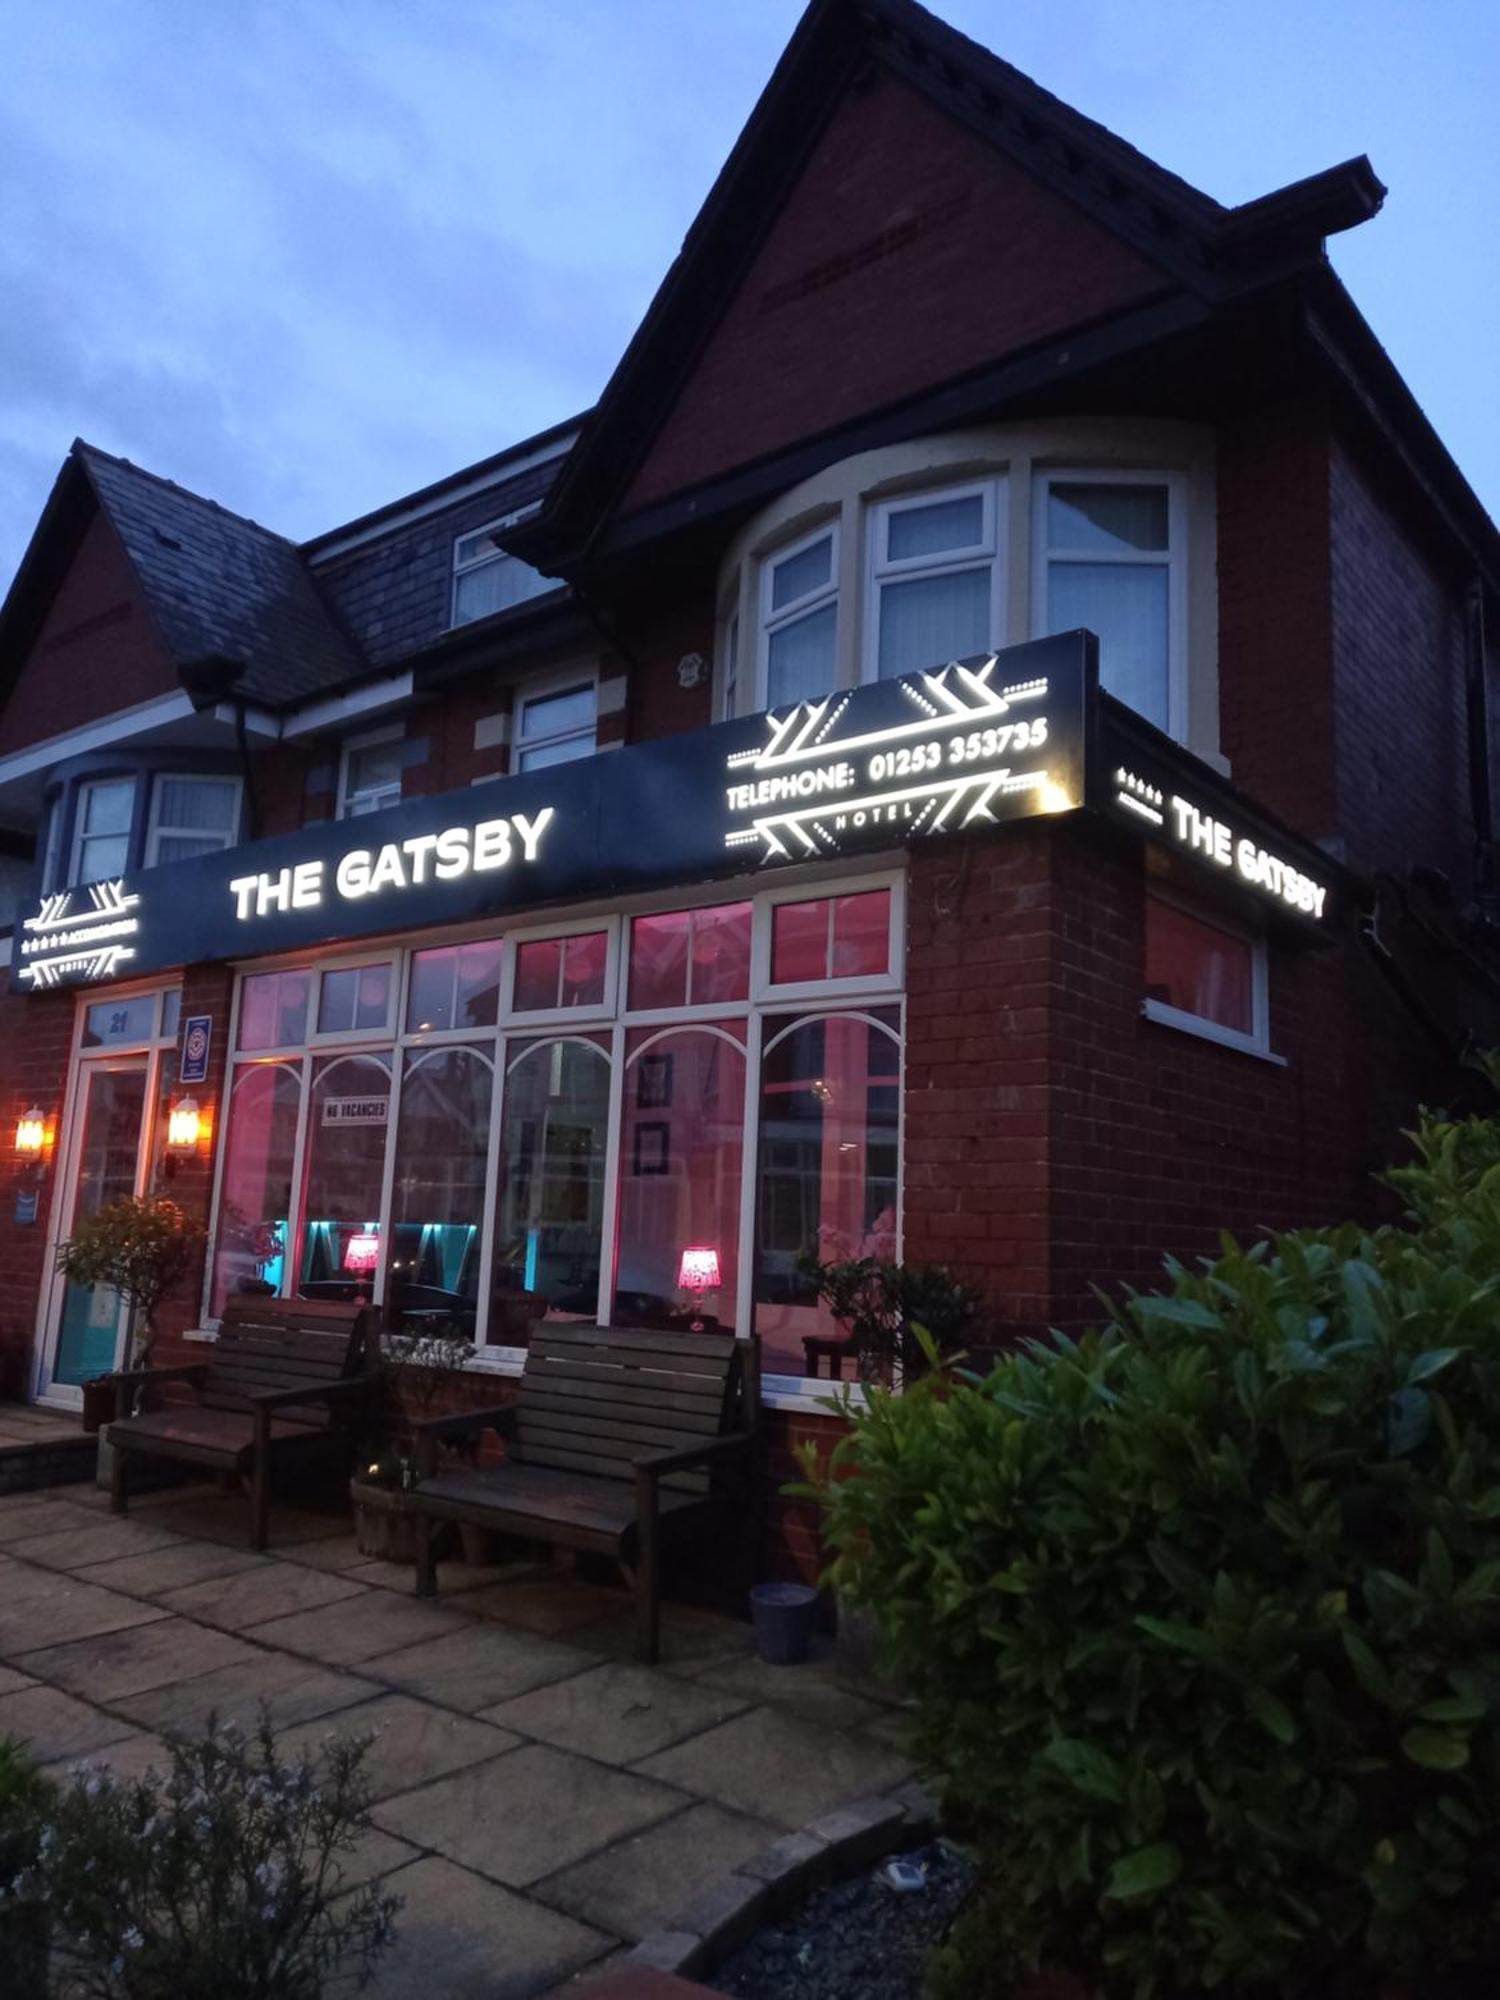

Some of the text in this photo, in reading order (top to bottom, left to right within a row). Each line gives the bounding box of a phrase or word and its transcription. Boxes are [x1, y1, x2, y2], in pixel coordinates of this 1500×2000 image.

[726, 716, 1048, 811] TELEPHONE: 01253 353735
[229, 806, 555, 920] THE GATSBY
[835, 801, 912, 830] HOTEL
[1171, 794, 1233, 867] THE
[1236, 838, 1327, 919] GATSBY
[110, 1010, 128, 1034] 21
